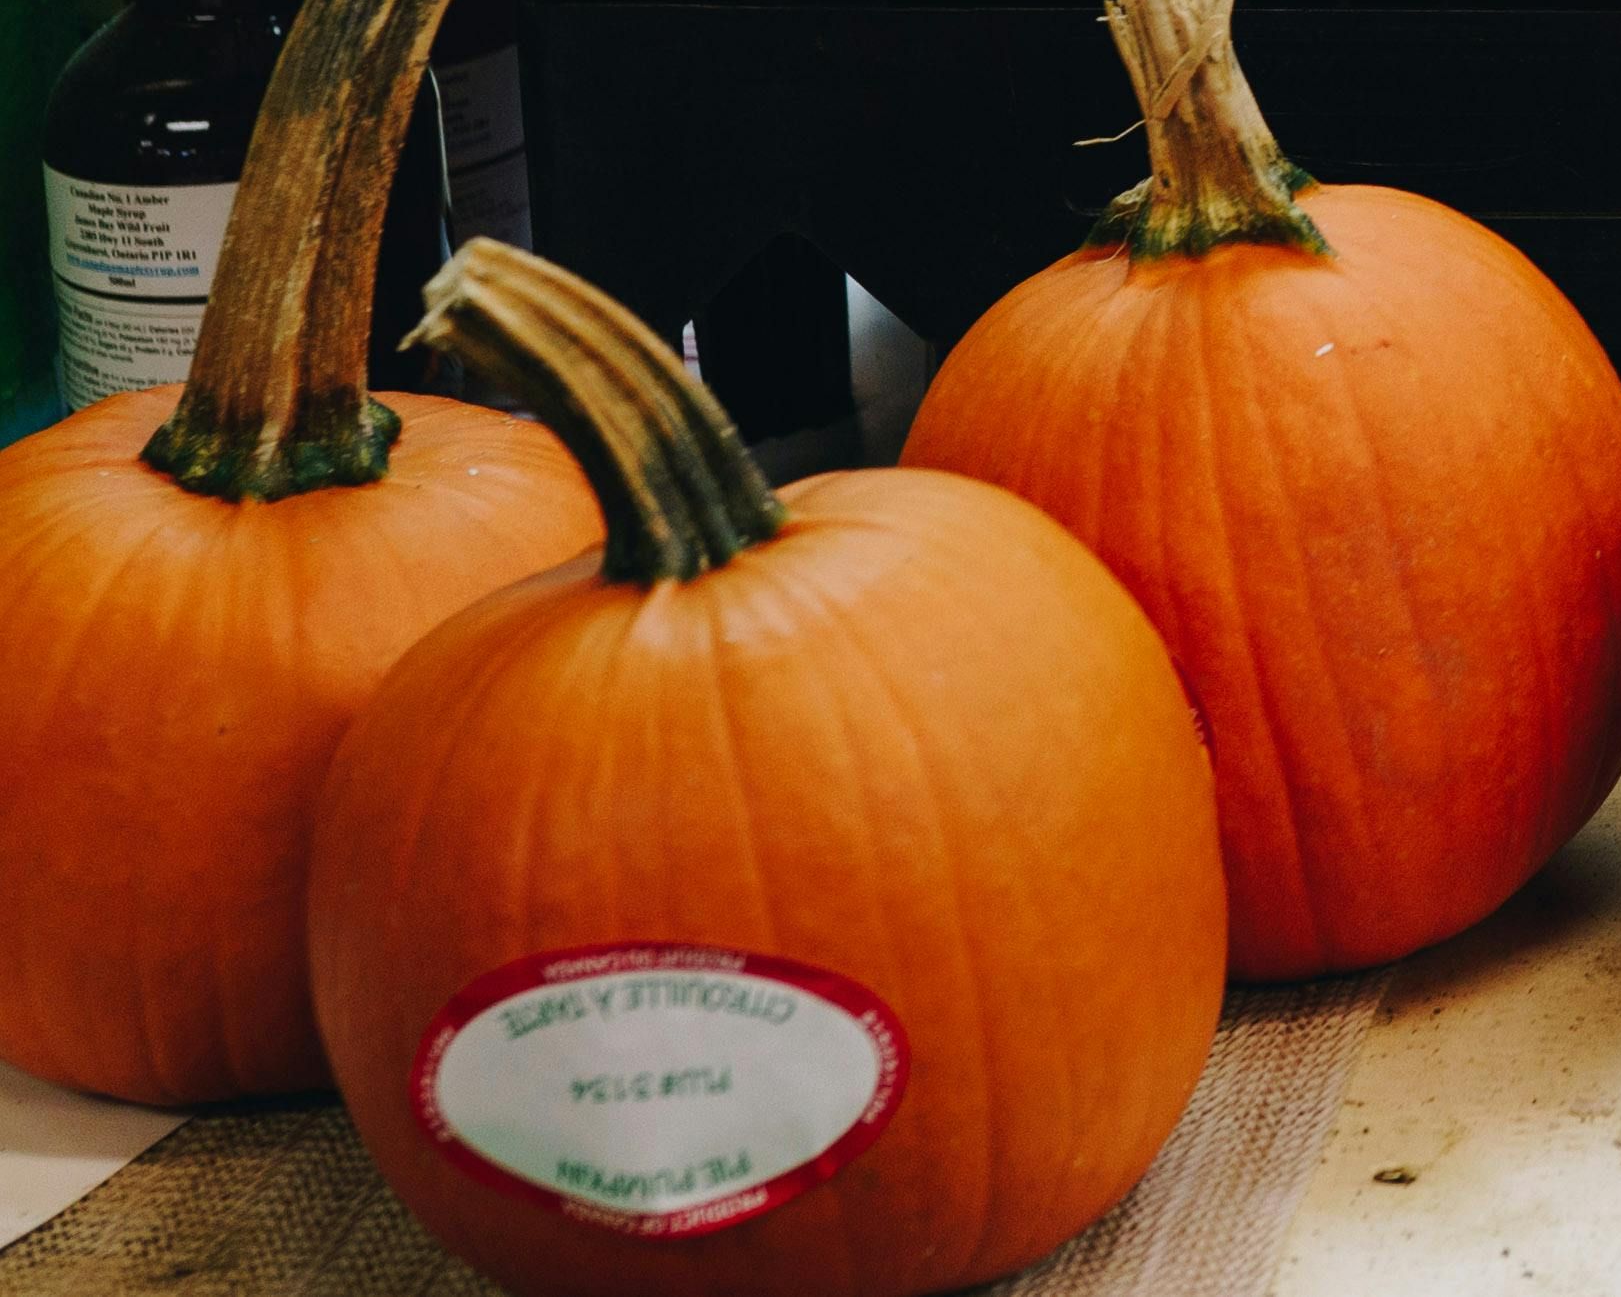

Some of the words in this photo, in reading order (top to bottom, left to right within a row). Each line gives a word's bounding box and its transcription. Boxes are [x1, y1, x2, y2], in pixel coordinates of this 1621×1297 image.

[622, 977, 798, 1026] CITROUILLE
[555, 1159, 698, 1200] PUMPKIN
[700, 1148, 752, 1185] PIE
